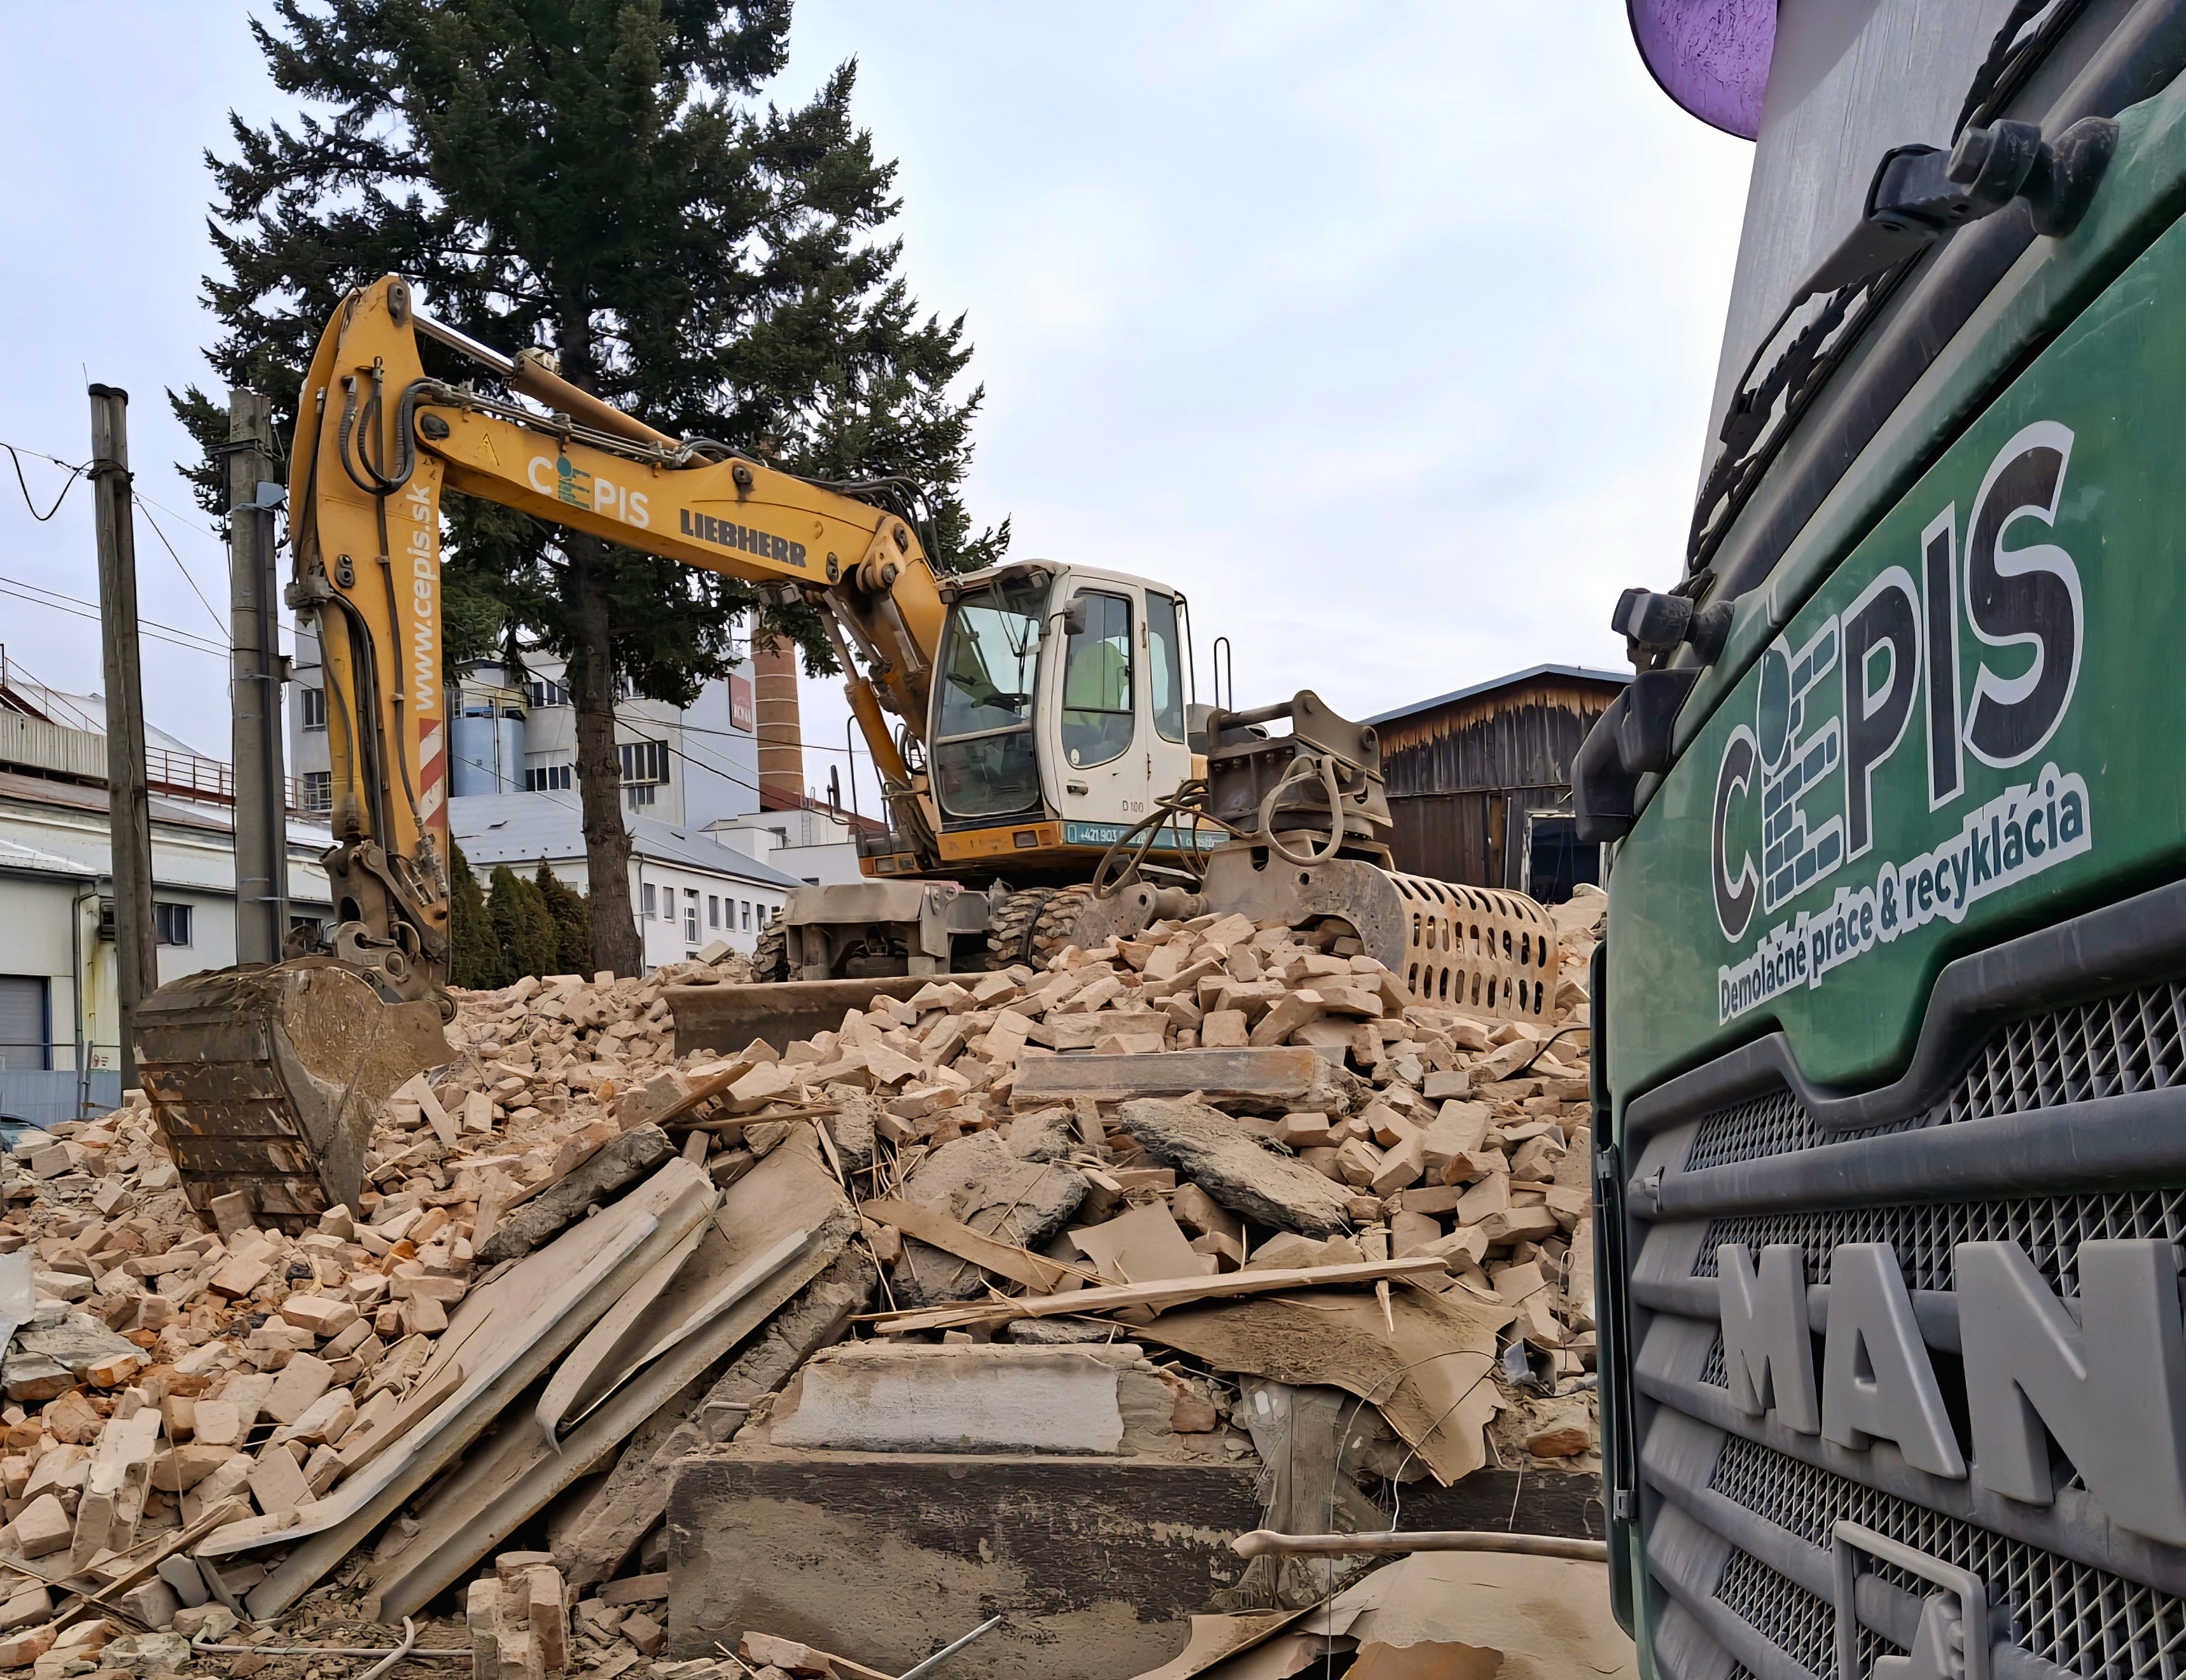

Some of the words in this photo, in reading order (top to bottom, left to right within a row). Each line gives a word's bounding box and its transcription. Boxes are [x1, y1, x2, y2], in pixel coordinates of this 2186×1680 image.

[406, 483, 438, 711] www.cepis.sk
[528, 455, 649, 528] CEPIS
[680, 509, 806, 567] LIEBHERR
[1713, 421, 2083, 941] CEPIS
[1720, 929, 1806, 1018] Demolačné
[1813, 901, 1873, 980] práce
[1881, 877, 1897, 931] &
[1906, 780, 2084, 919] recyklácia
[1716, 1238, 2186, 1548] MAN
